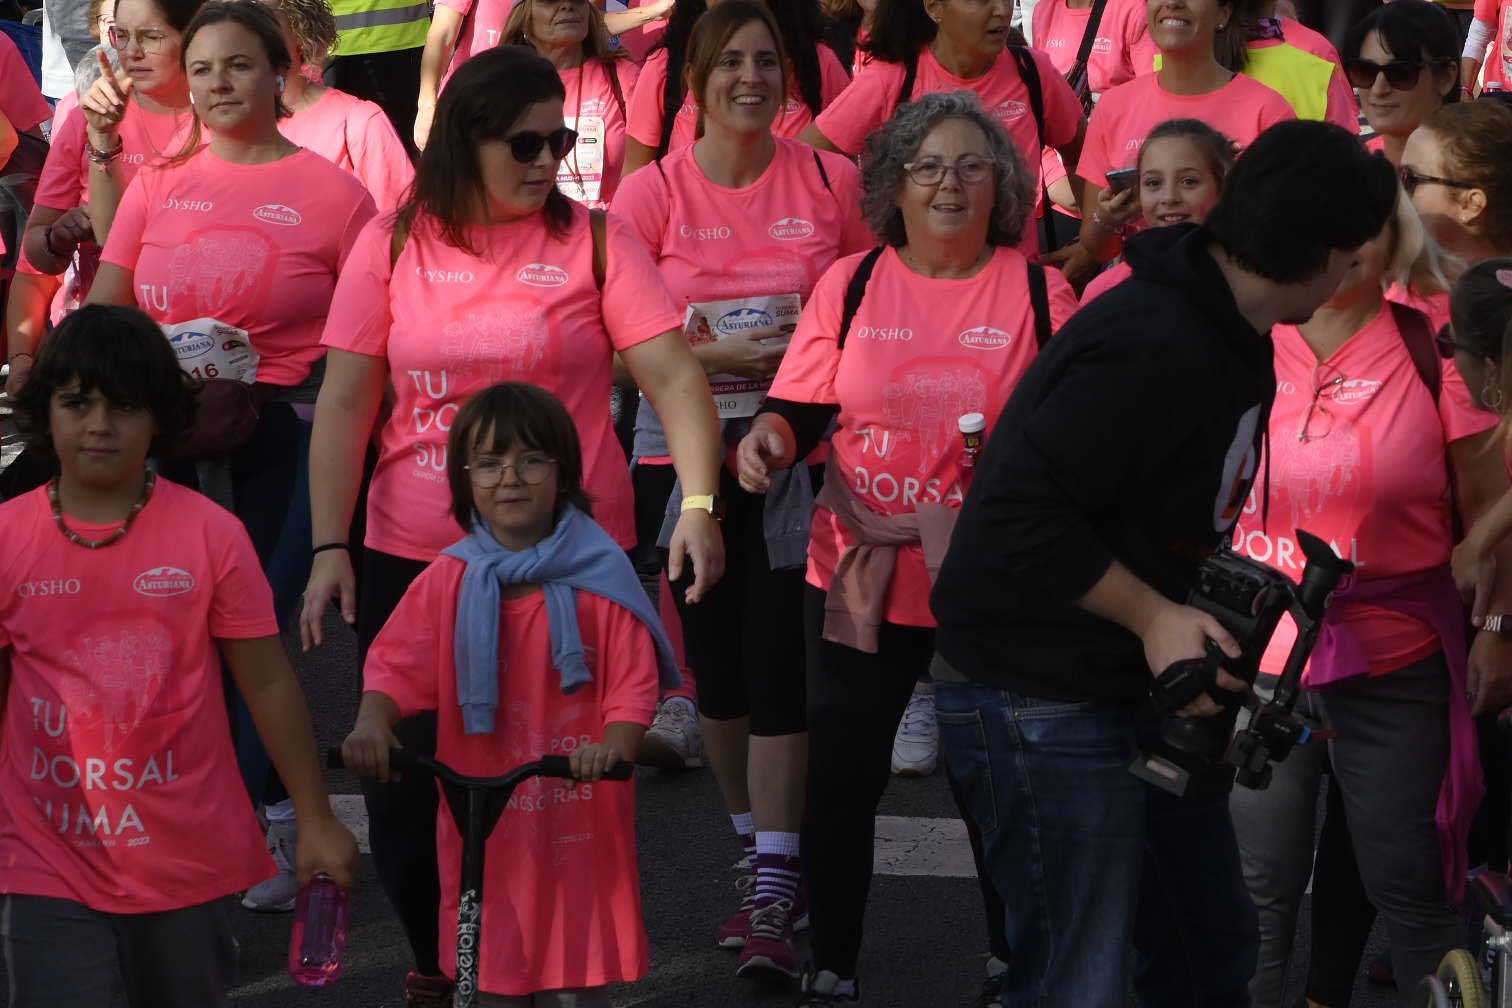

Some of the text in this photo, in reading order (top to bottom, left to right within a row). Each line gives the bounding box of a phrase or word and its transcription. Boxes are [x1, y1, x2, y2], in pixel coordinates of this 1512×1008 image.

[140, 284, 169, 312] TU
[722, 319, 768, 331] ASTURIANA
[858, 327, 912, 342] OYSHO
[408, 370, 448, 400] TU
[19, 578, 81, 599] OYSHO
[138, 573, 191, 591] ASTURIANA
[31, 696, 66, 738] TU
[30, 749, 179, 792] DORSAL
